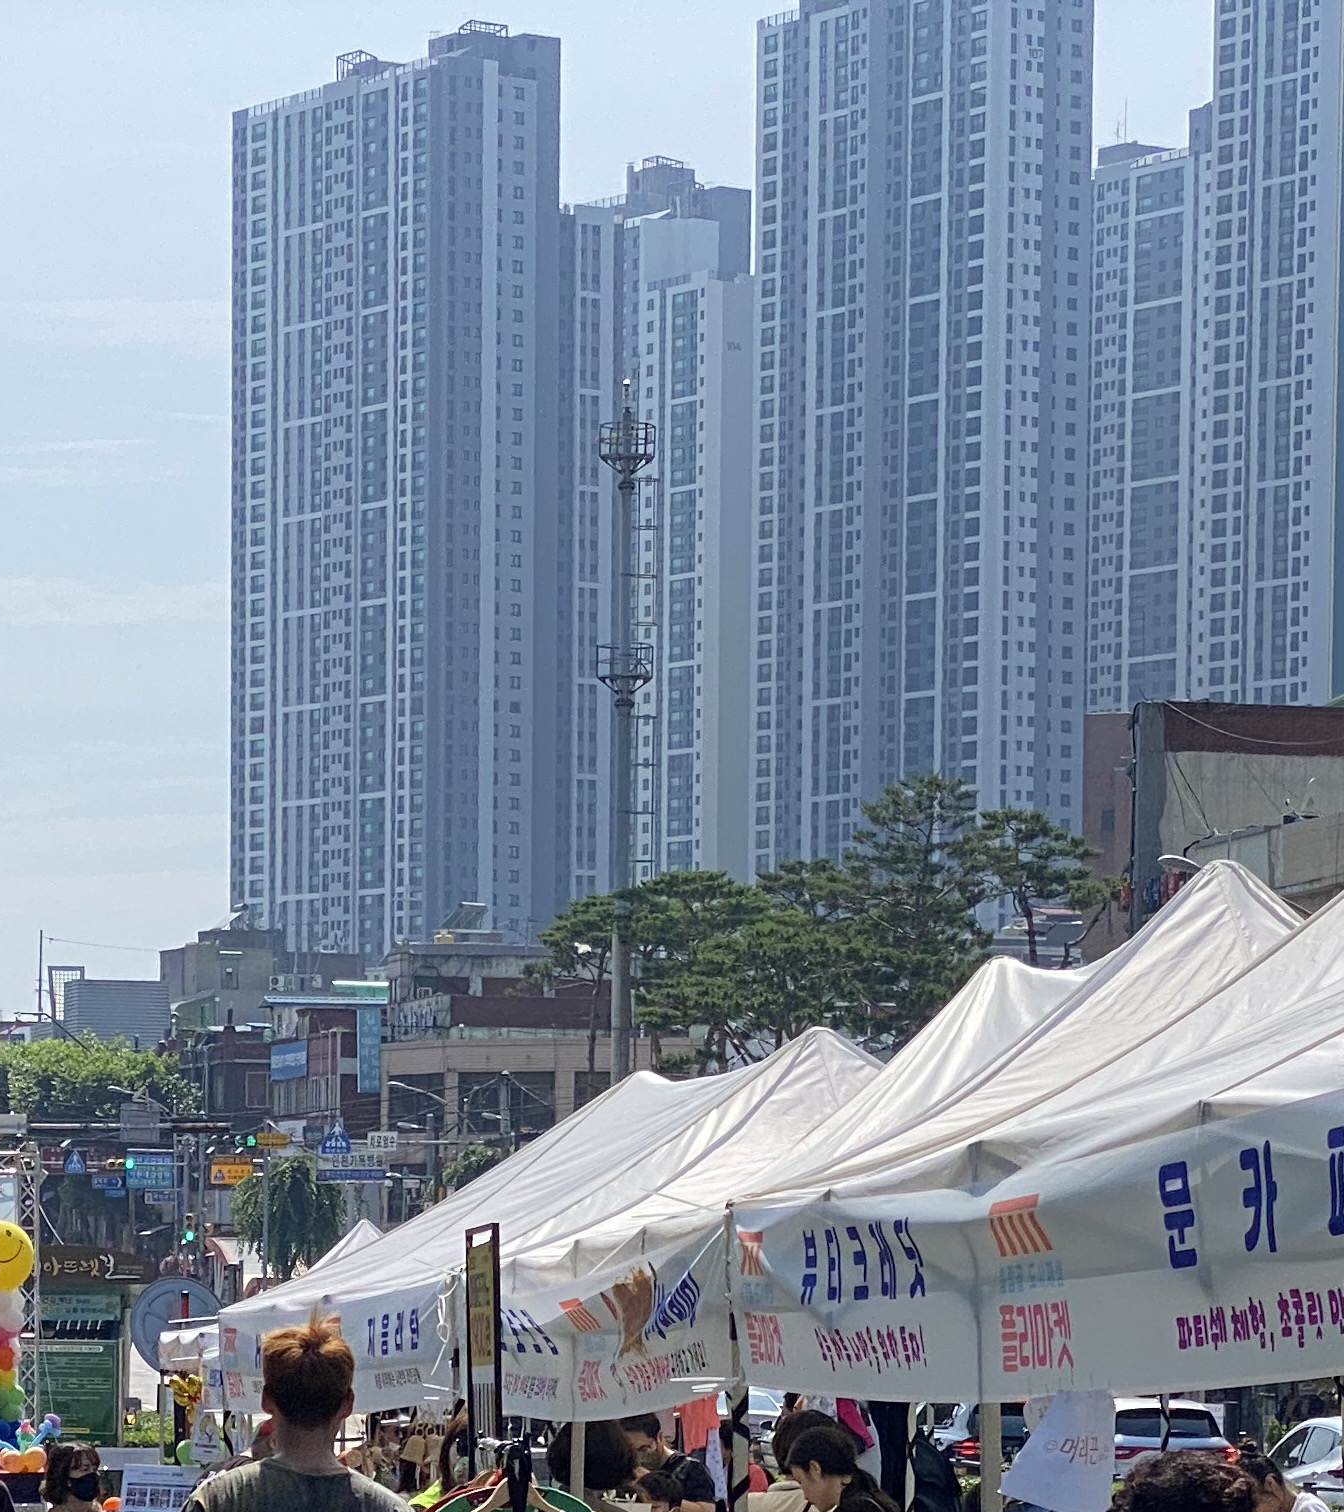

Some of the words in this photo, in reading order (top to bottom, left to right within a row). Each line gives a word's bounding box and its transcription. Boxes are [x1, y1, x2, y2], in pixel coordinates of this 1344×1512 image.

[999, 1299, 1075, 1373] 플리마켓
[1231, 1295, 1276, 1352] 체험,
[1277, 1287, 1325, 1350] 초콜릿
